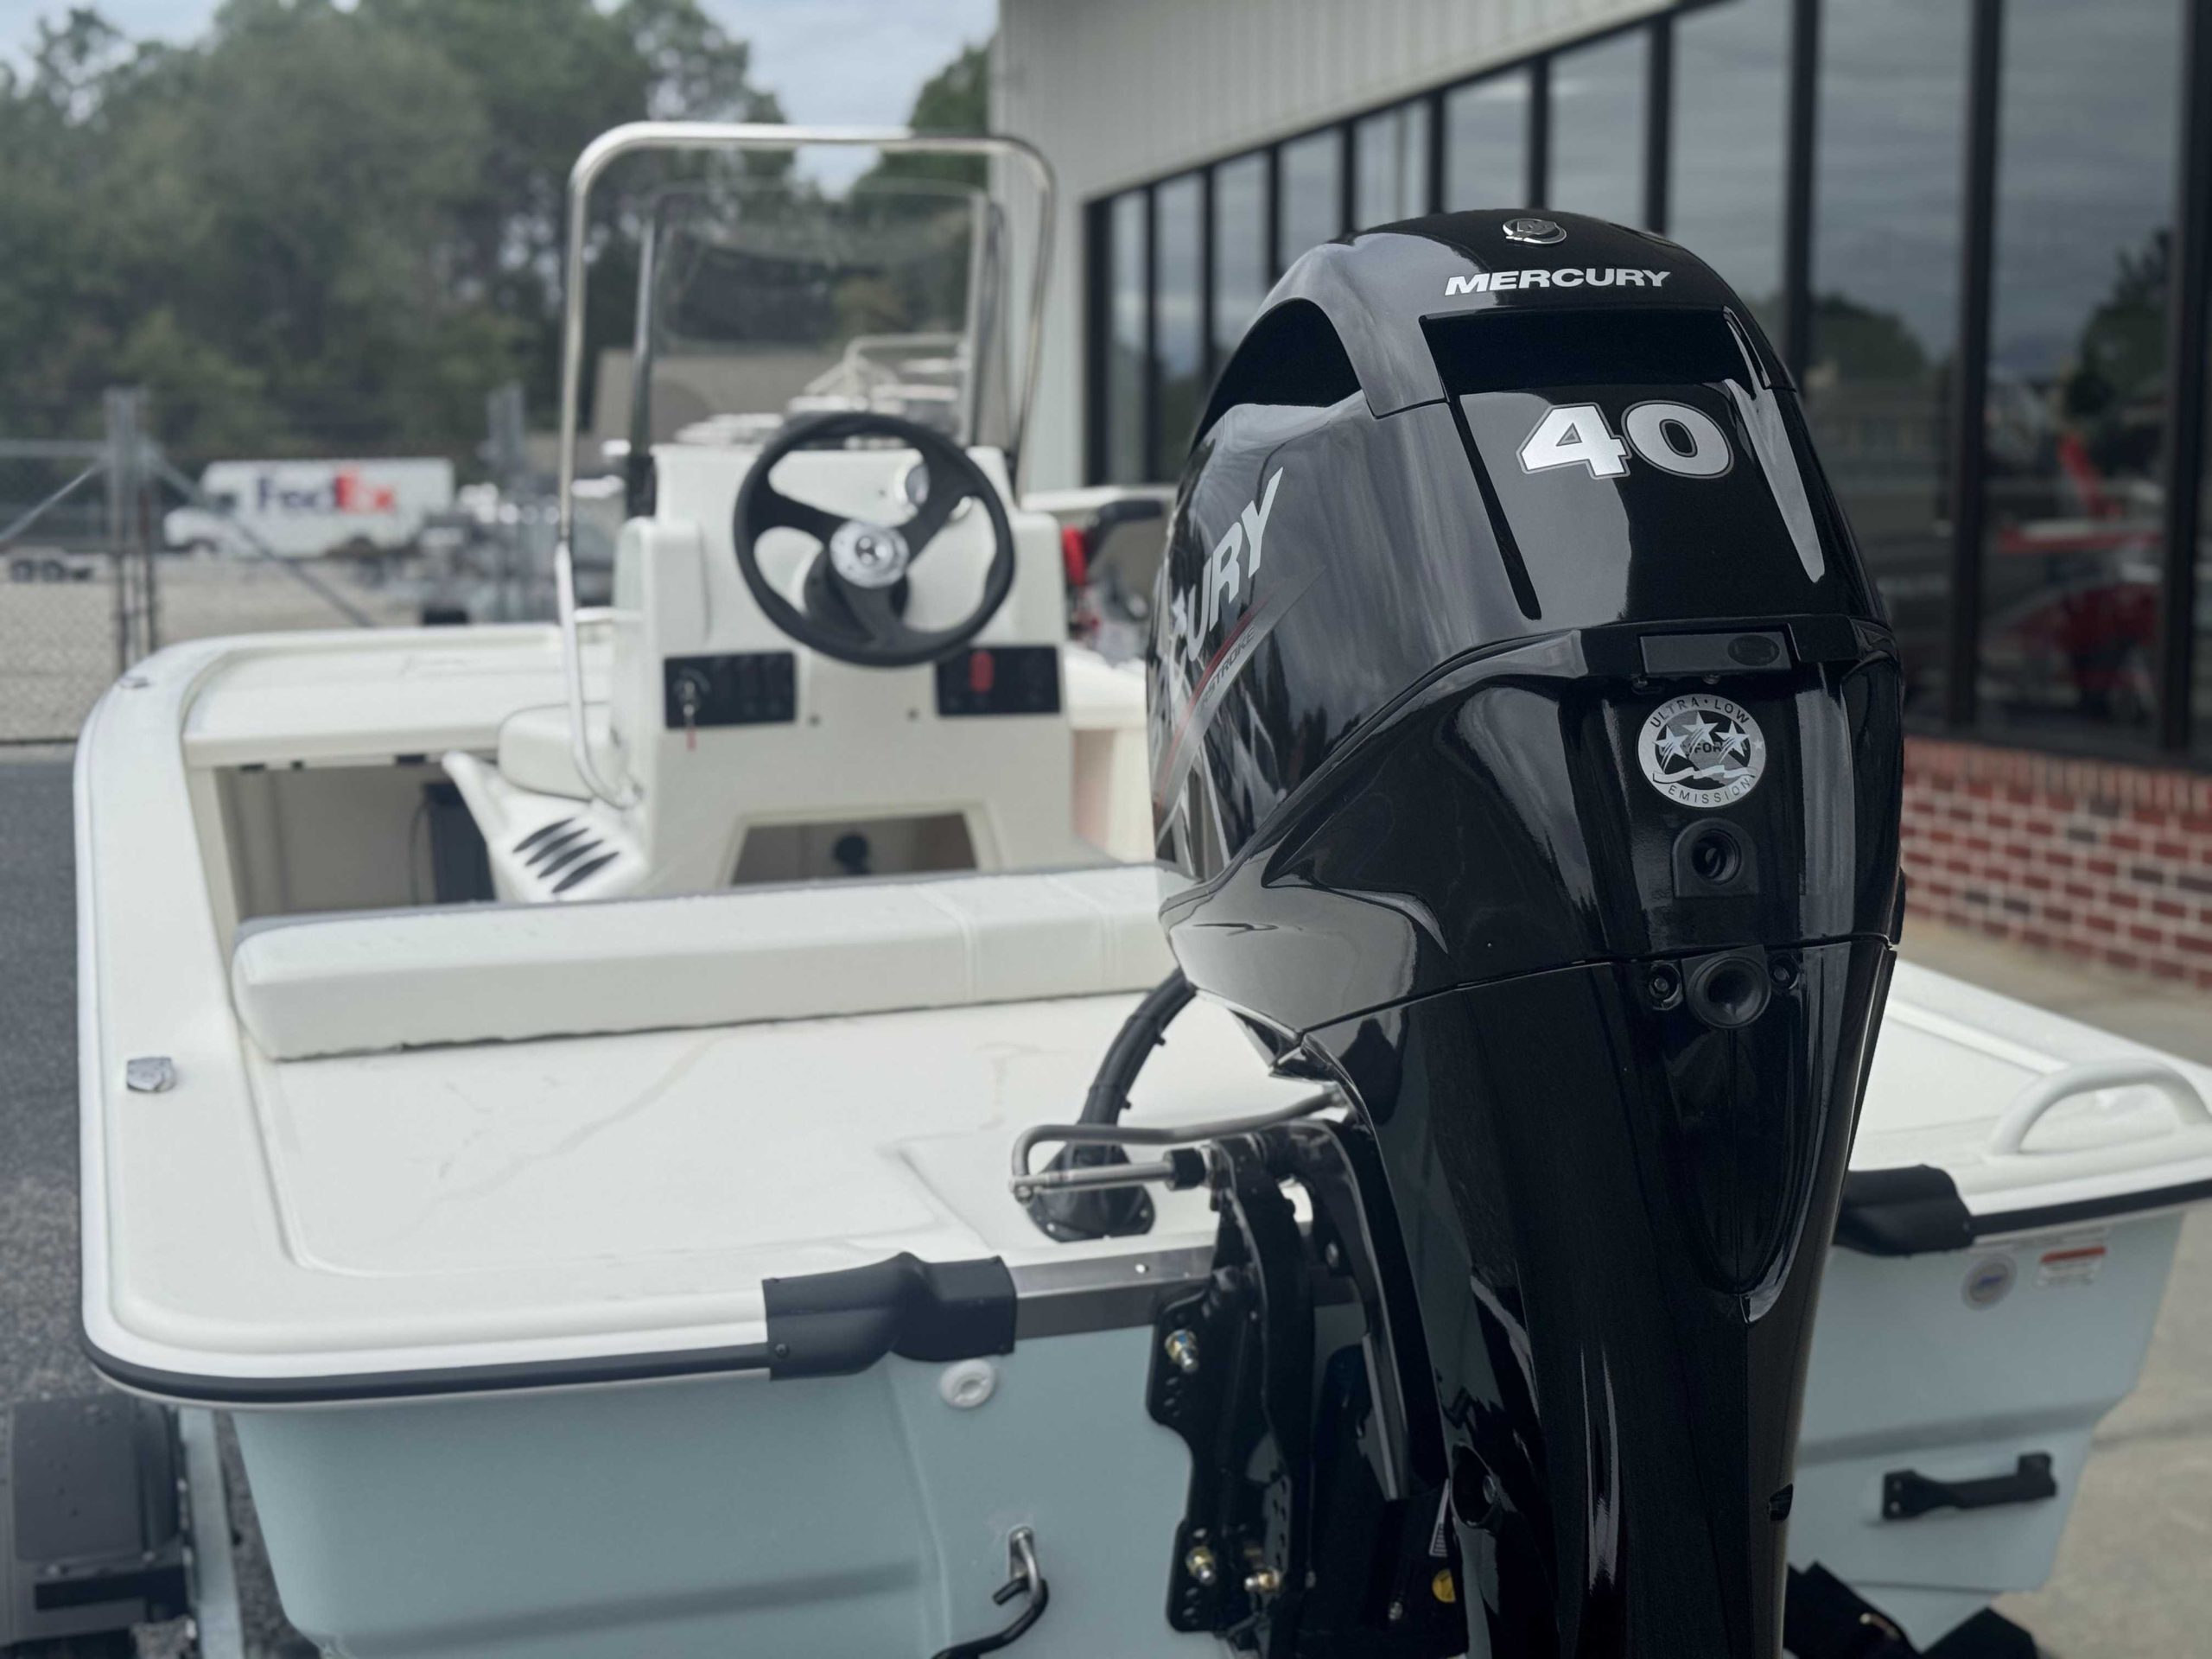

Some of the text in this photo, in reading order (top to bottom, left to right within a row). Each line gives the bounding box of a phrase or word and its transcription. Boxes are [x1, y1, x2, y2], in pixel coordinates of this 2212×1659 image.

[1445, 268, 1671, 296] MERCURY
[1516, 400, 1733, 479] 40
[1650, 697, 1750, 728] ULTRA LOW
[1669, 778, 1751, 804] EMISSION
